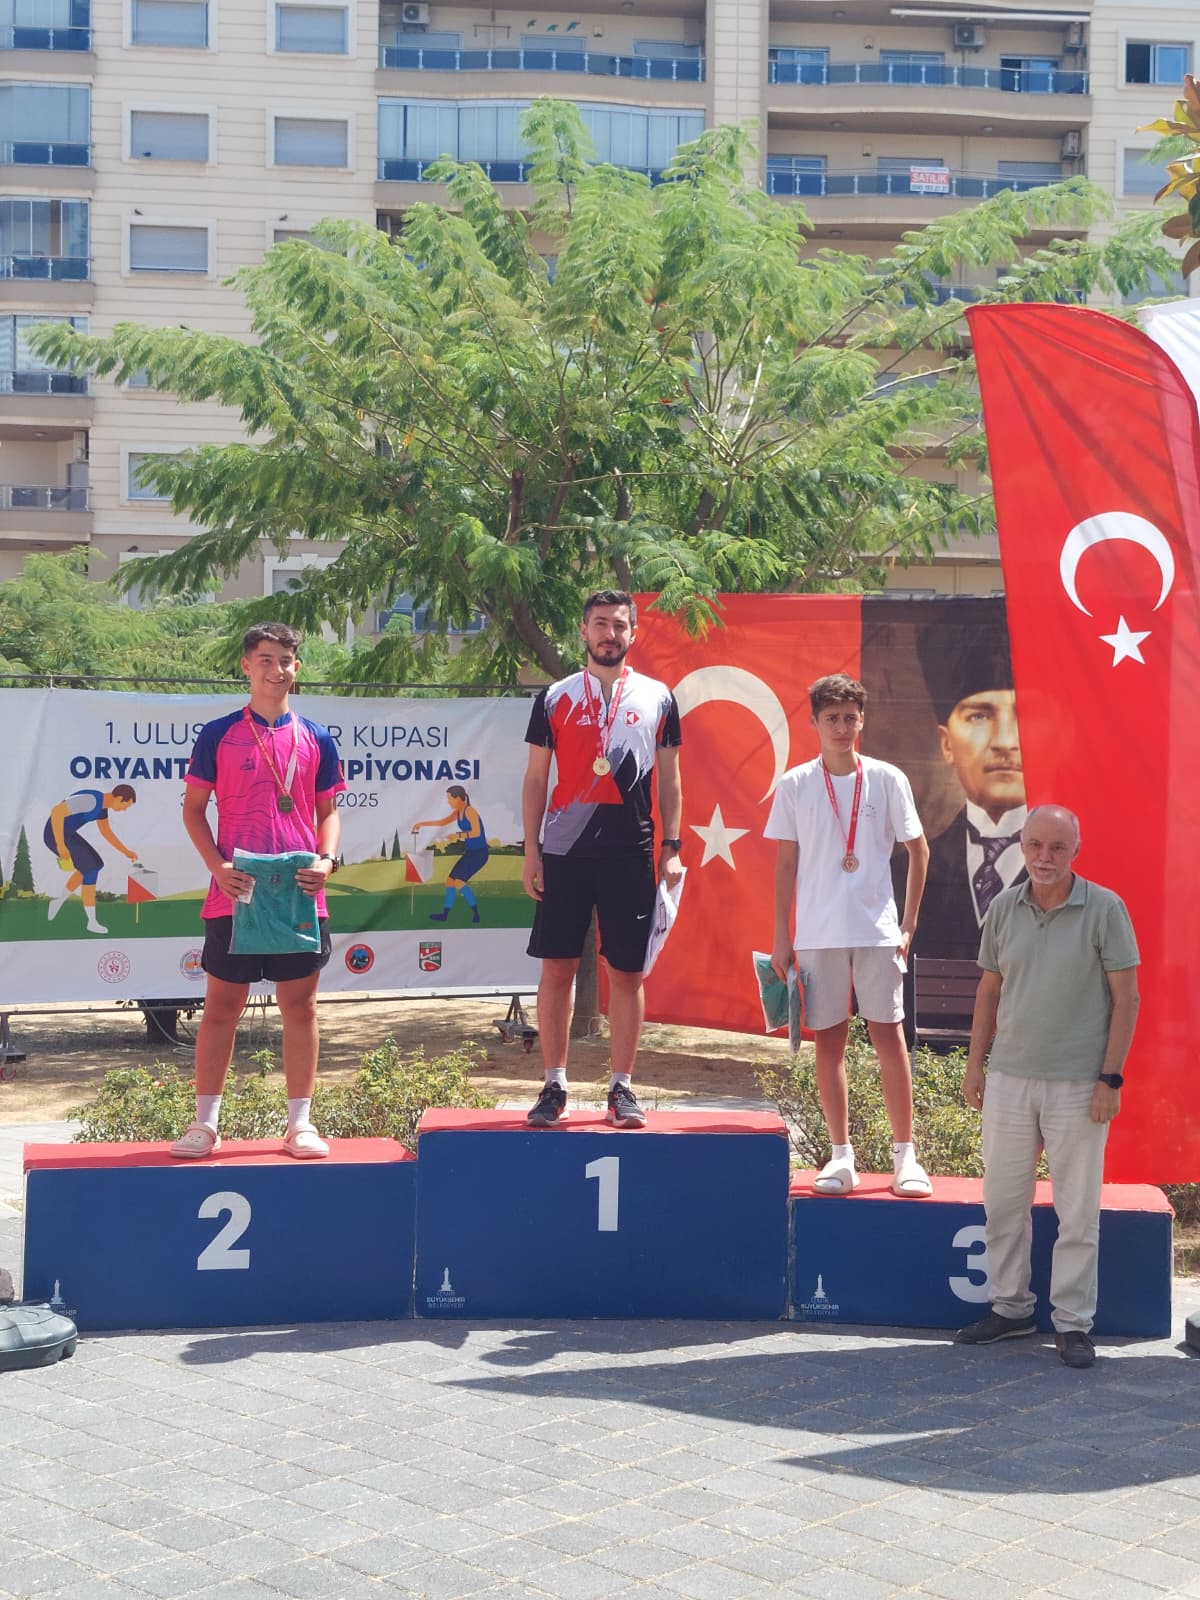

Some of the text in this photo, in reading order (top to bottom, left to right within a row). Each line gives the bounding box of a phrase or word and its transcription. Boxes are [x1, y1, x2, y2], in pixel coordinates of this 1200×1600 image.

[911, 173, 947, 184] SATILIK
[105, 722, 121, 744] 1.
[353, 725, 448, 748] KUPASI
[70, 752, 480, 781] ORYANT PİYONASI
[336, 792, 379, 808] 2025
[585, 1156, 620, 1232] 1
[197, 1191, 251, 1270] 2
[949, 1224, 992, 1304] 3
